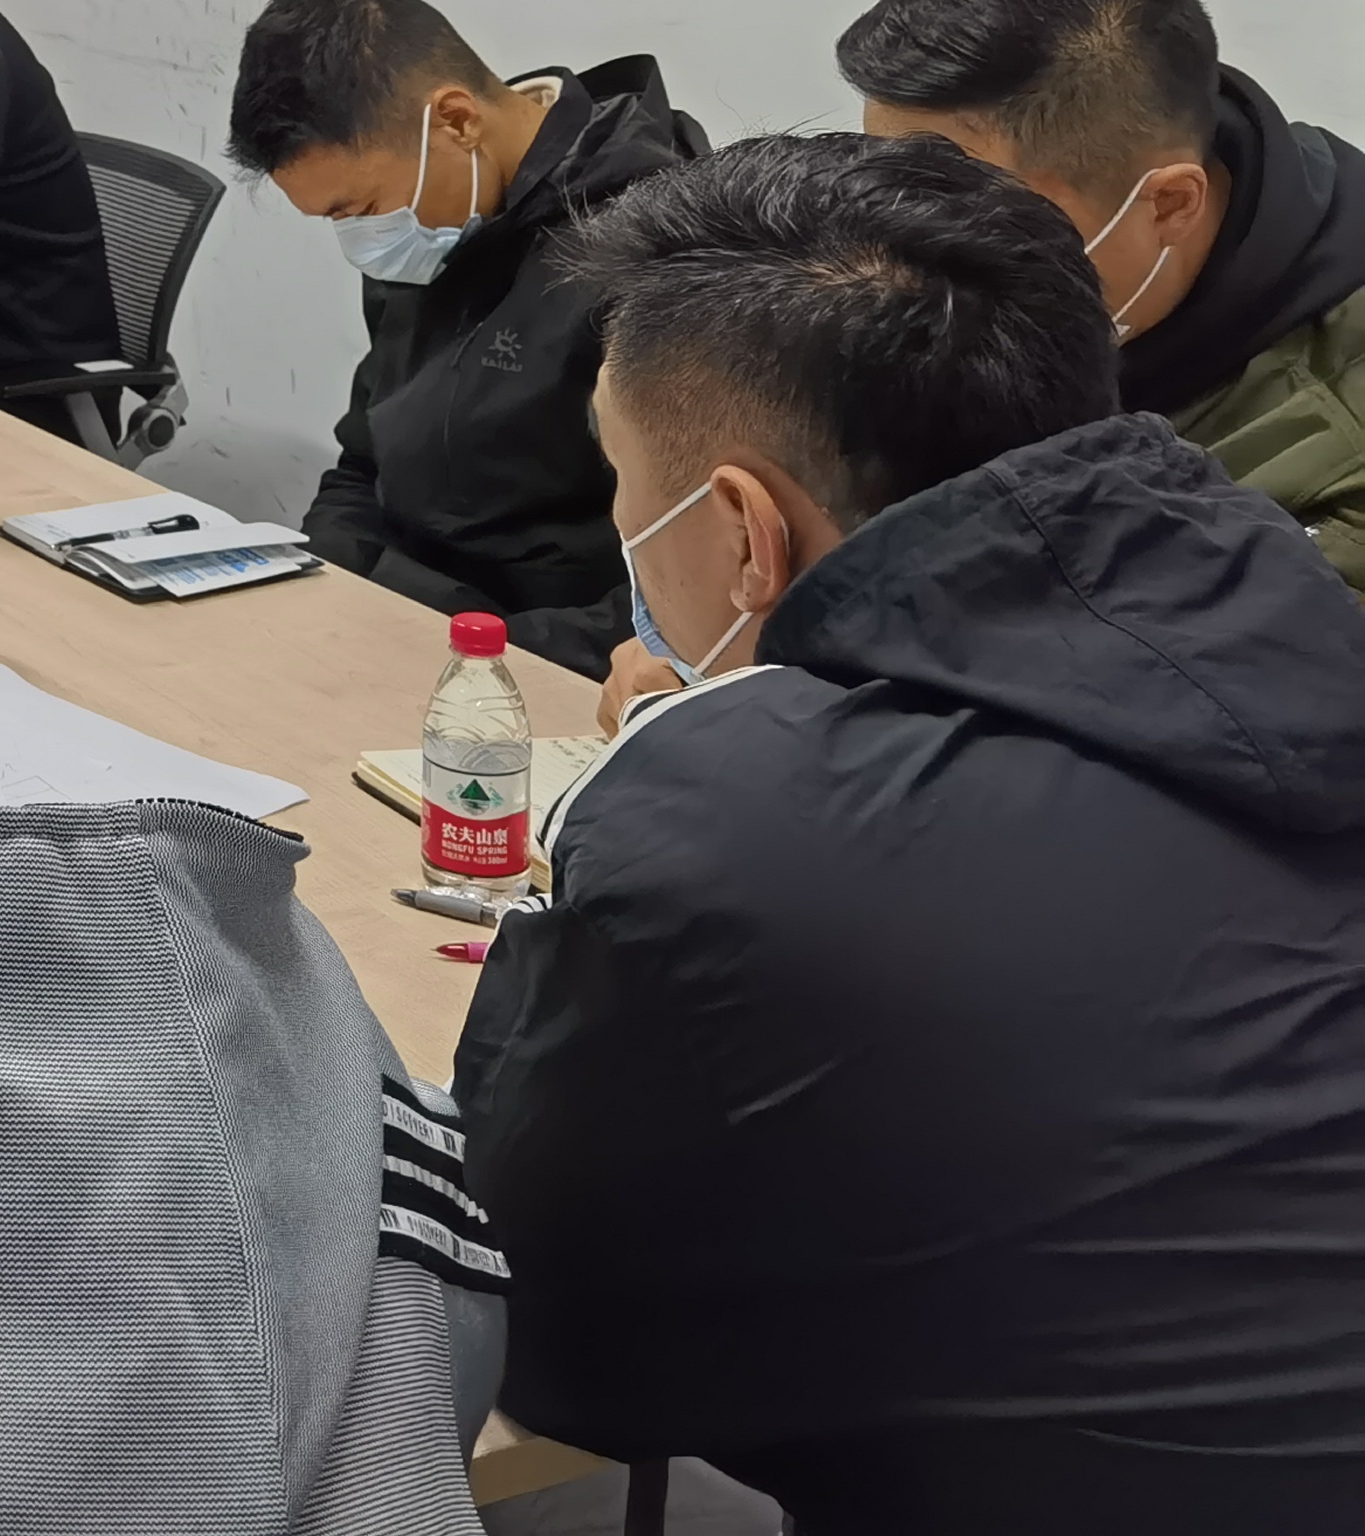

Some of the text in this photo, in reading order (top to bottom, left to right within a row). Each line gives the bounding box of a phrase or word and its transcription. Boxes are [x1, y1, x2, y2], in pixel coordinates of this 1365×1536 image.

[442, 823, 508, 845] 农夫山泉
[477, 846, 507, 855] SPRING
